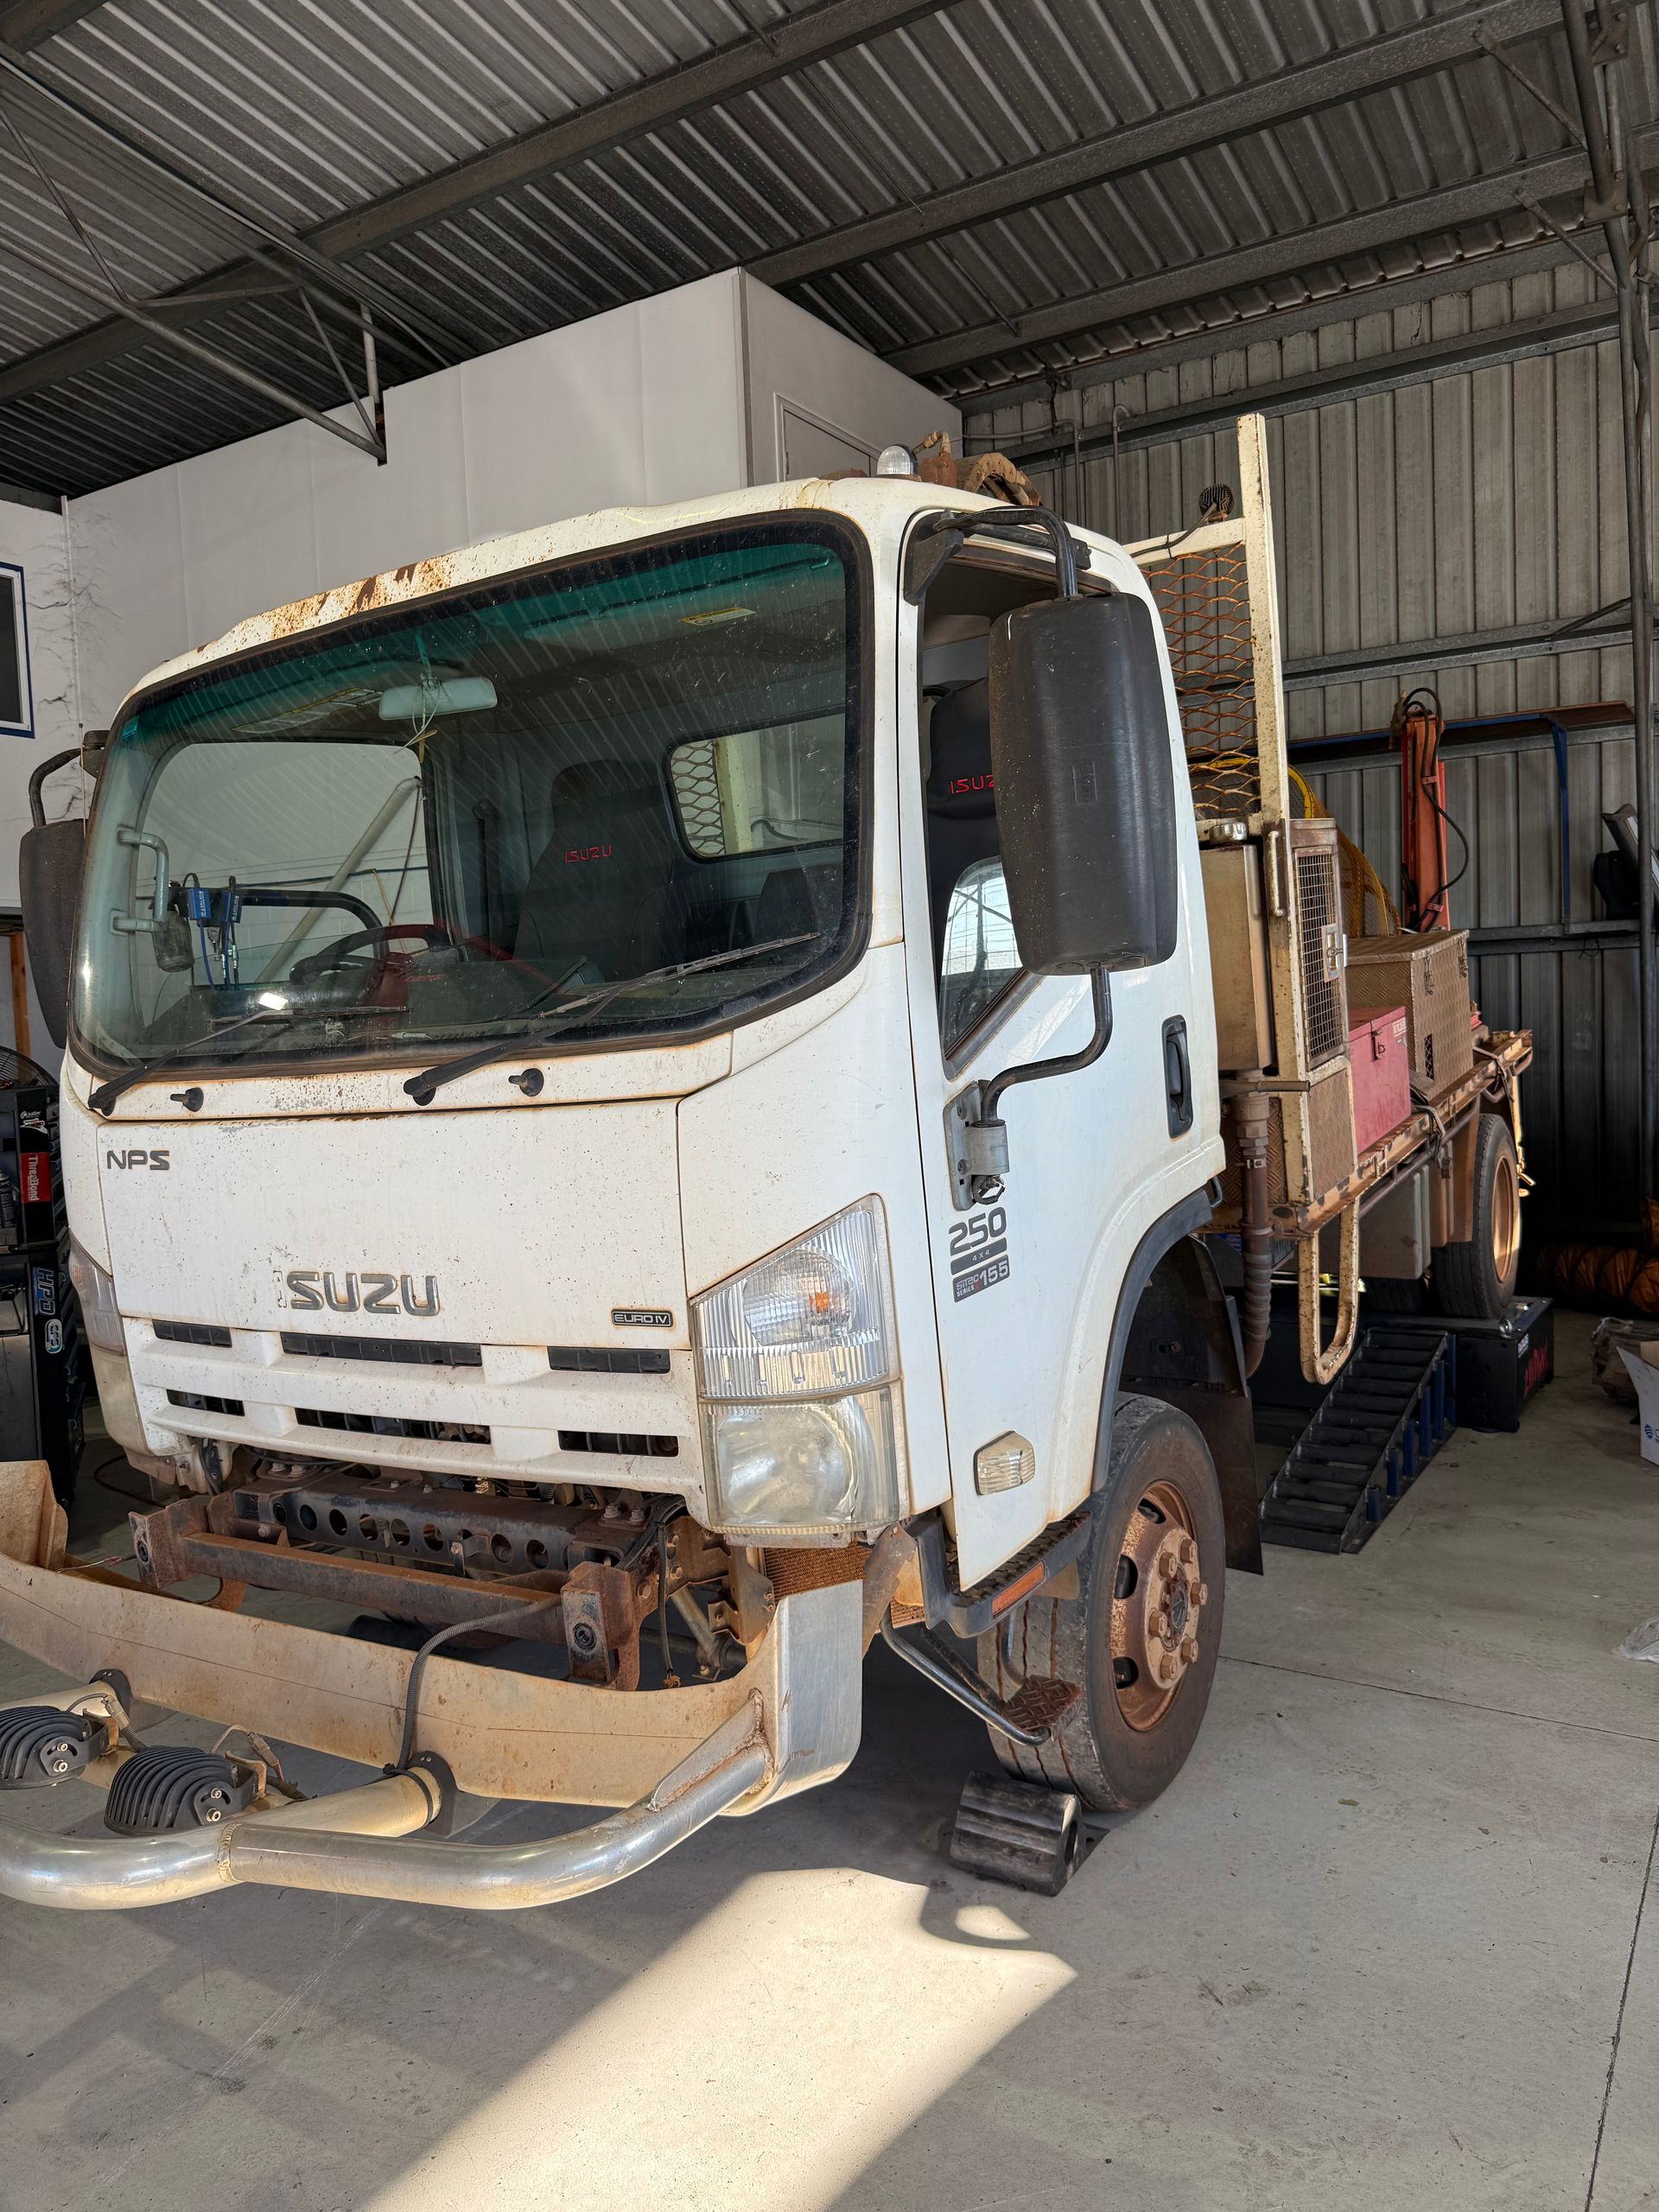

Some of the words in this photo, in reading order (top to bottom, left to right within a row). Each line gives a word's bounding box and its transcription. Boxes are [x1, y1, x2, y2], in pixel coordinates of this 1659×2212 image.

[950, 774, 995, 795] ISUZ
[563, 843, 612, 864] ISUZU
[106, 1149, 170, 1171] NPS
[28, 1154, 40, 1202] ThreeBond
[948, 1206, 1007, 1256] 250
[979, 1260, 1008, 1286] 155
[37, 1268, 55, 1315] HPD
[957, 1284, 975, 1297] SERIES
[613, 1314, 653, 1324] EURO
[655, 1315, 667, 1324] IV
